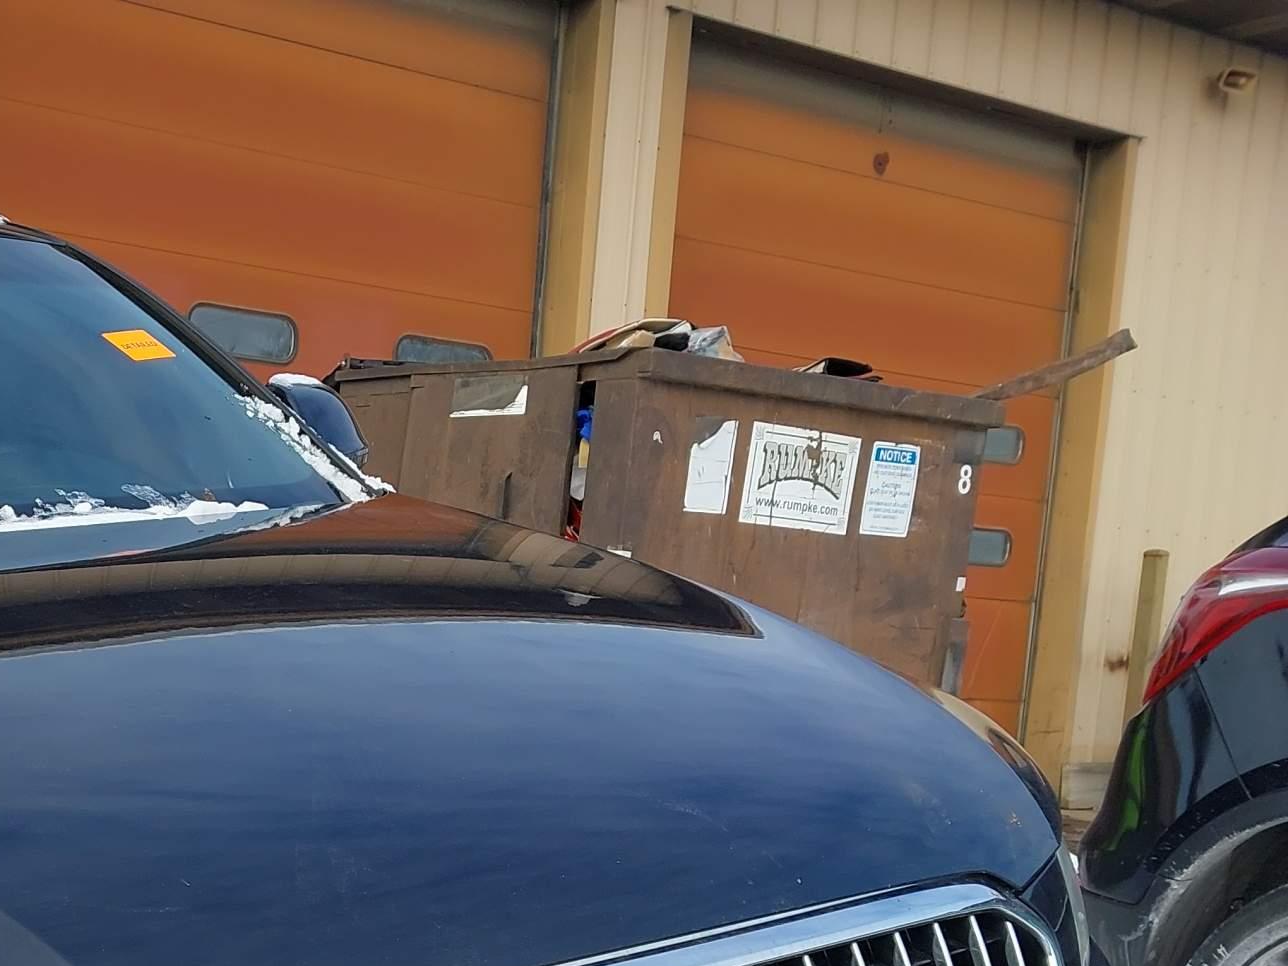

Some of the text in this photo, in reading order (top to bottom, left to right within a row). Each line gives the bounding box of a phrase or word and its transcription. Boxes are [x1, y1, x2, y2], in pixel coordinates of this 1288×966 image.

[879, 449, 913, 463] NOTICE
[758, 441, 847, 500] RUMKE
[958, 464, 972, 494] 8
[756, 496, 839, 516] www.rumpke.com
